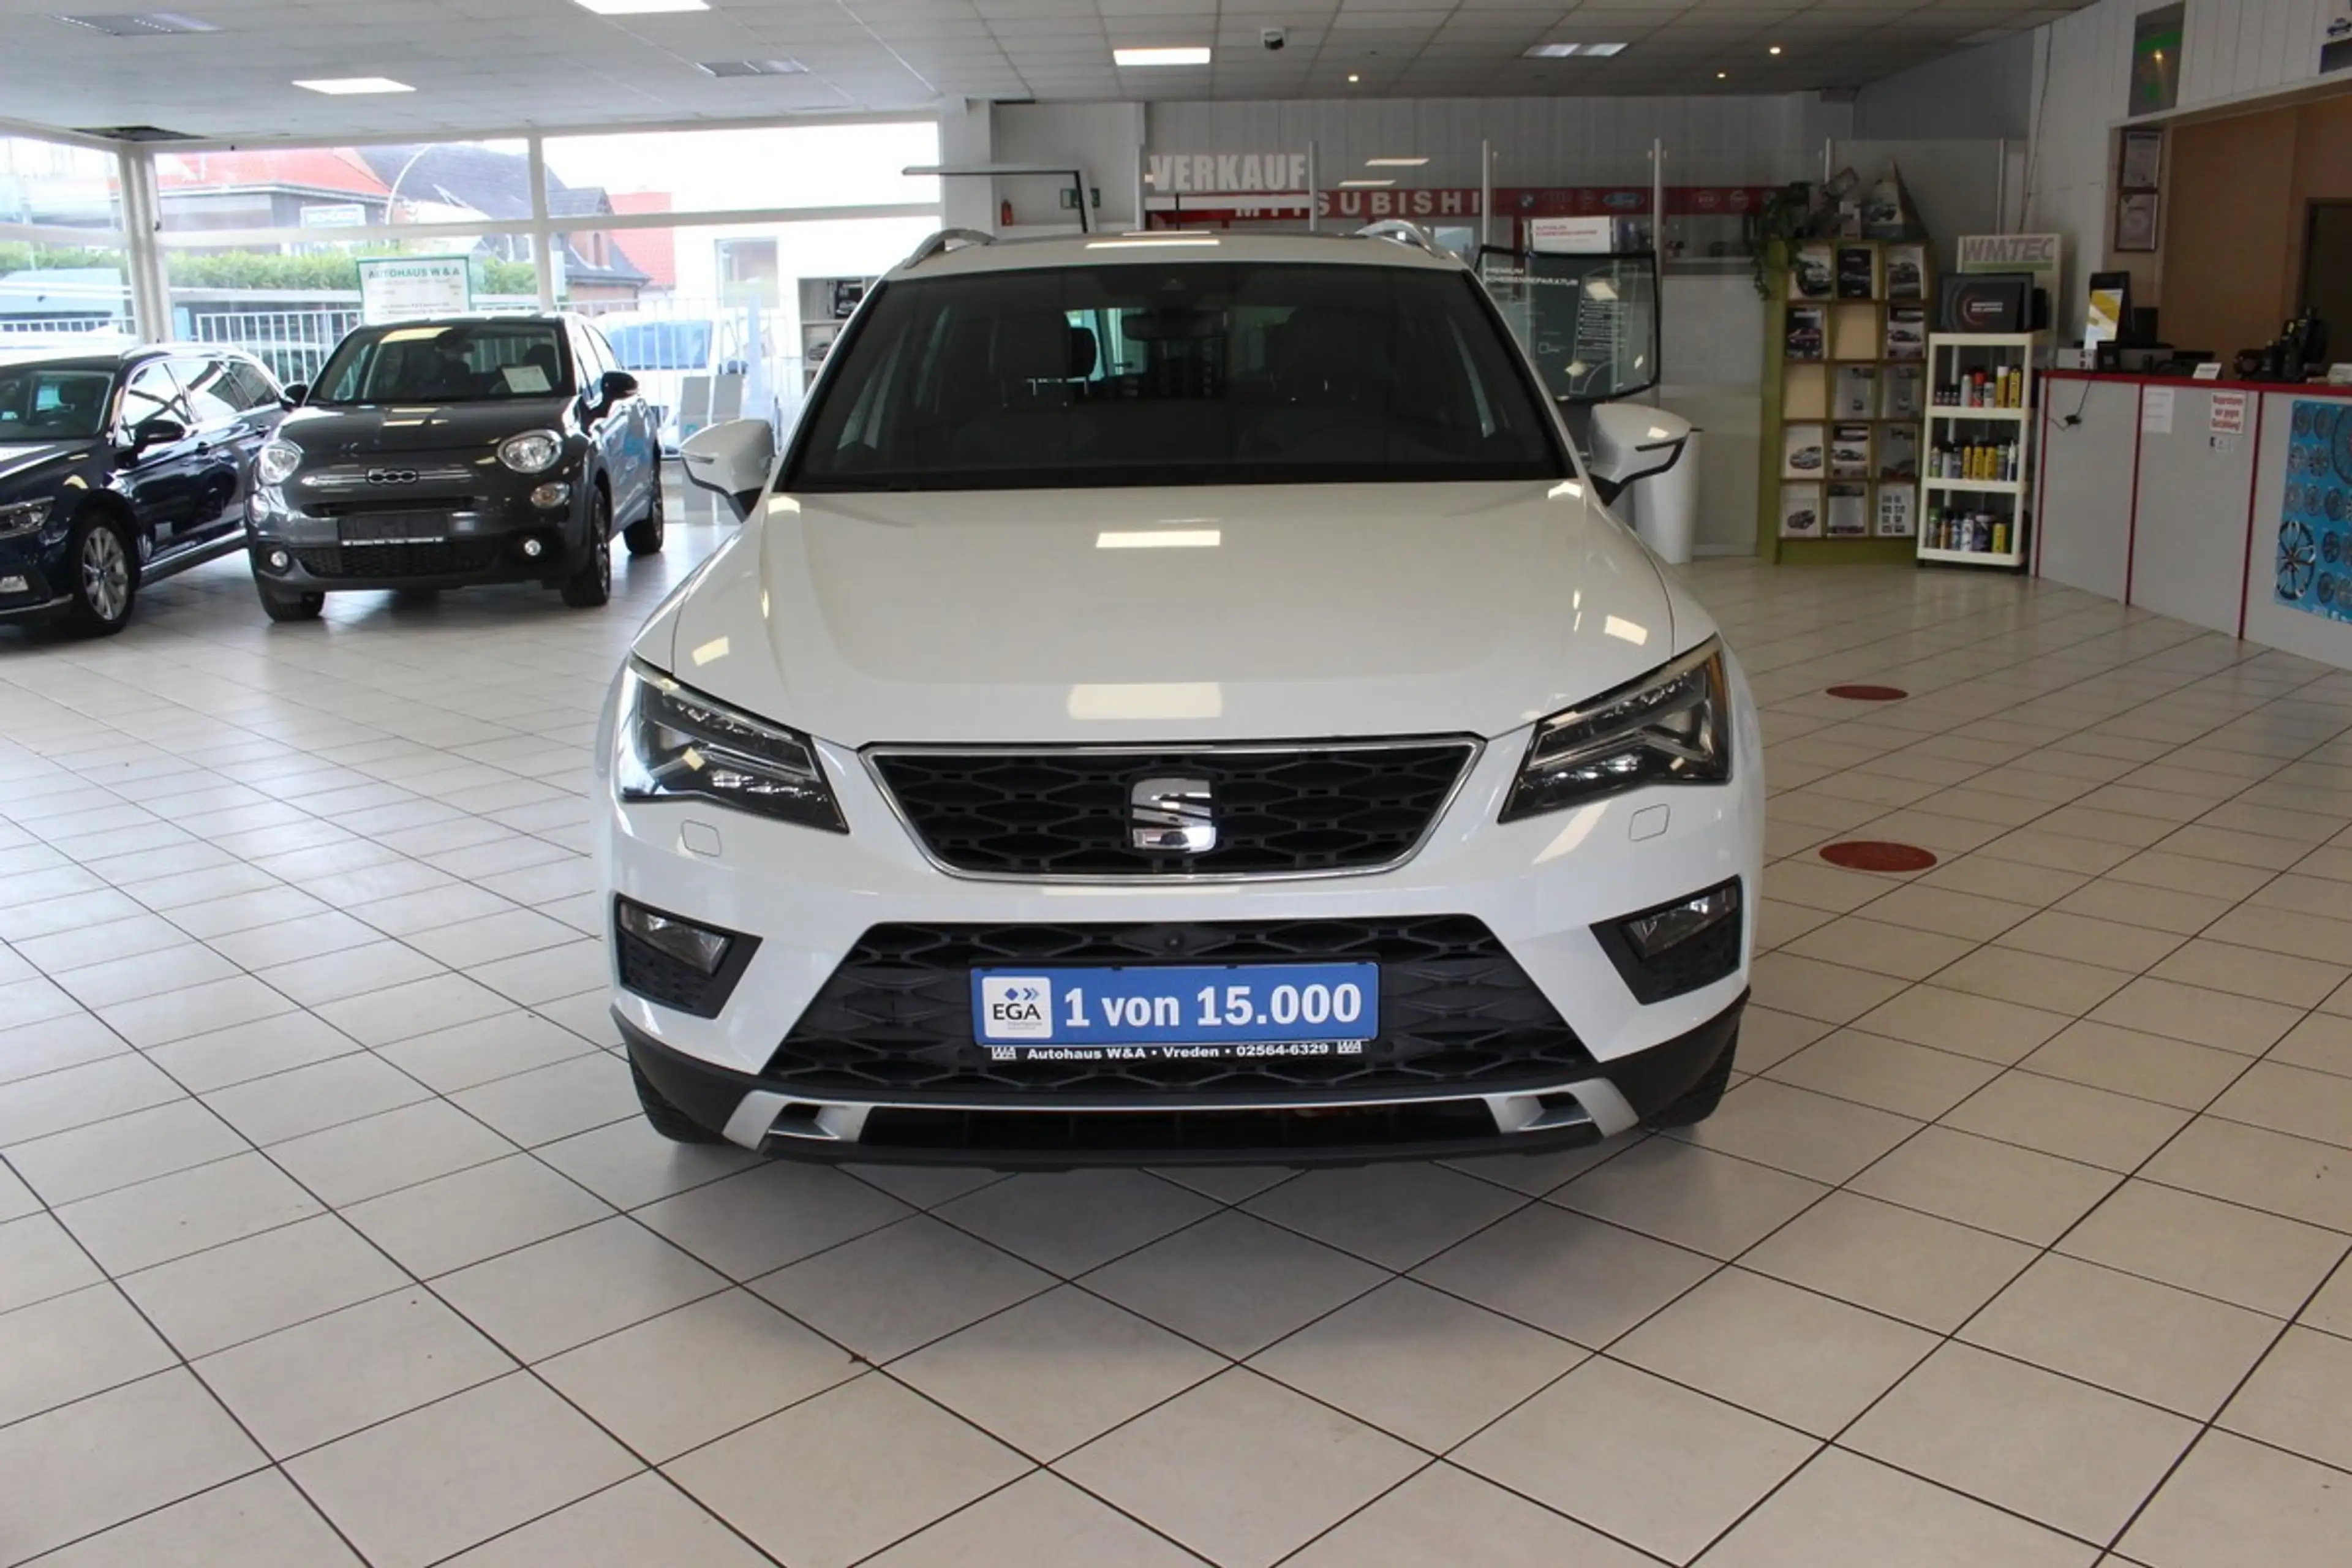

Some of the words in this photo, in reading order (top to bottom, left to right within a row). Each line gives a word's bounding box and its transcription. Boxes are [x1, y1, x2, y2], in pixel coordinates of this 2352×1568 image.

[1150, 154, 1306, 191] VERKAUF
[368, 267, 428, 279] AUTOHAUS
[993, 1002, 1041, 1020] EGA
[1064, 987, 1090, 1027] 1
[1102, 995, 1180, 1027] von
[1197, 982, 1361, 1027] 15.000
[1027, 1047, 1102, 1060] Autohaus
[1106, 1047, 1146, 1058] W&A
[1163, 1046, 1219, 1058] Vreden
[1236, 1042, 1329, 1057] 02564-6329
